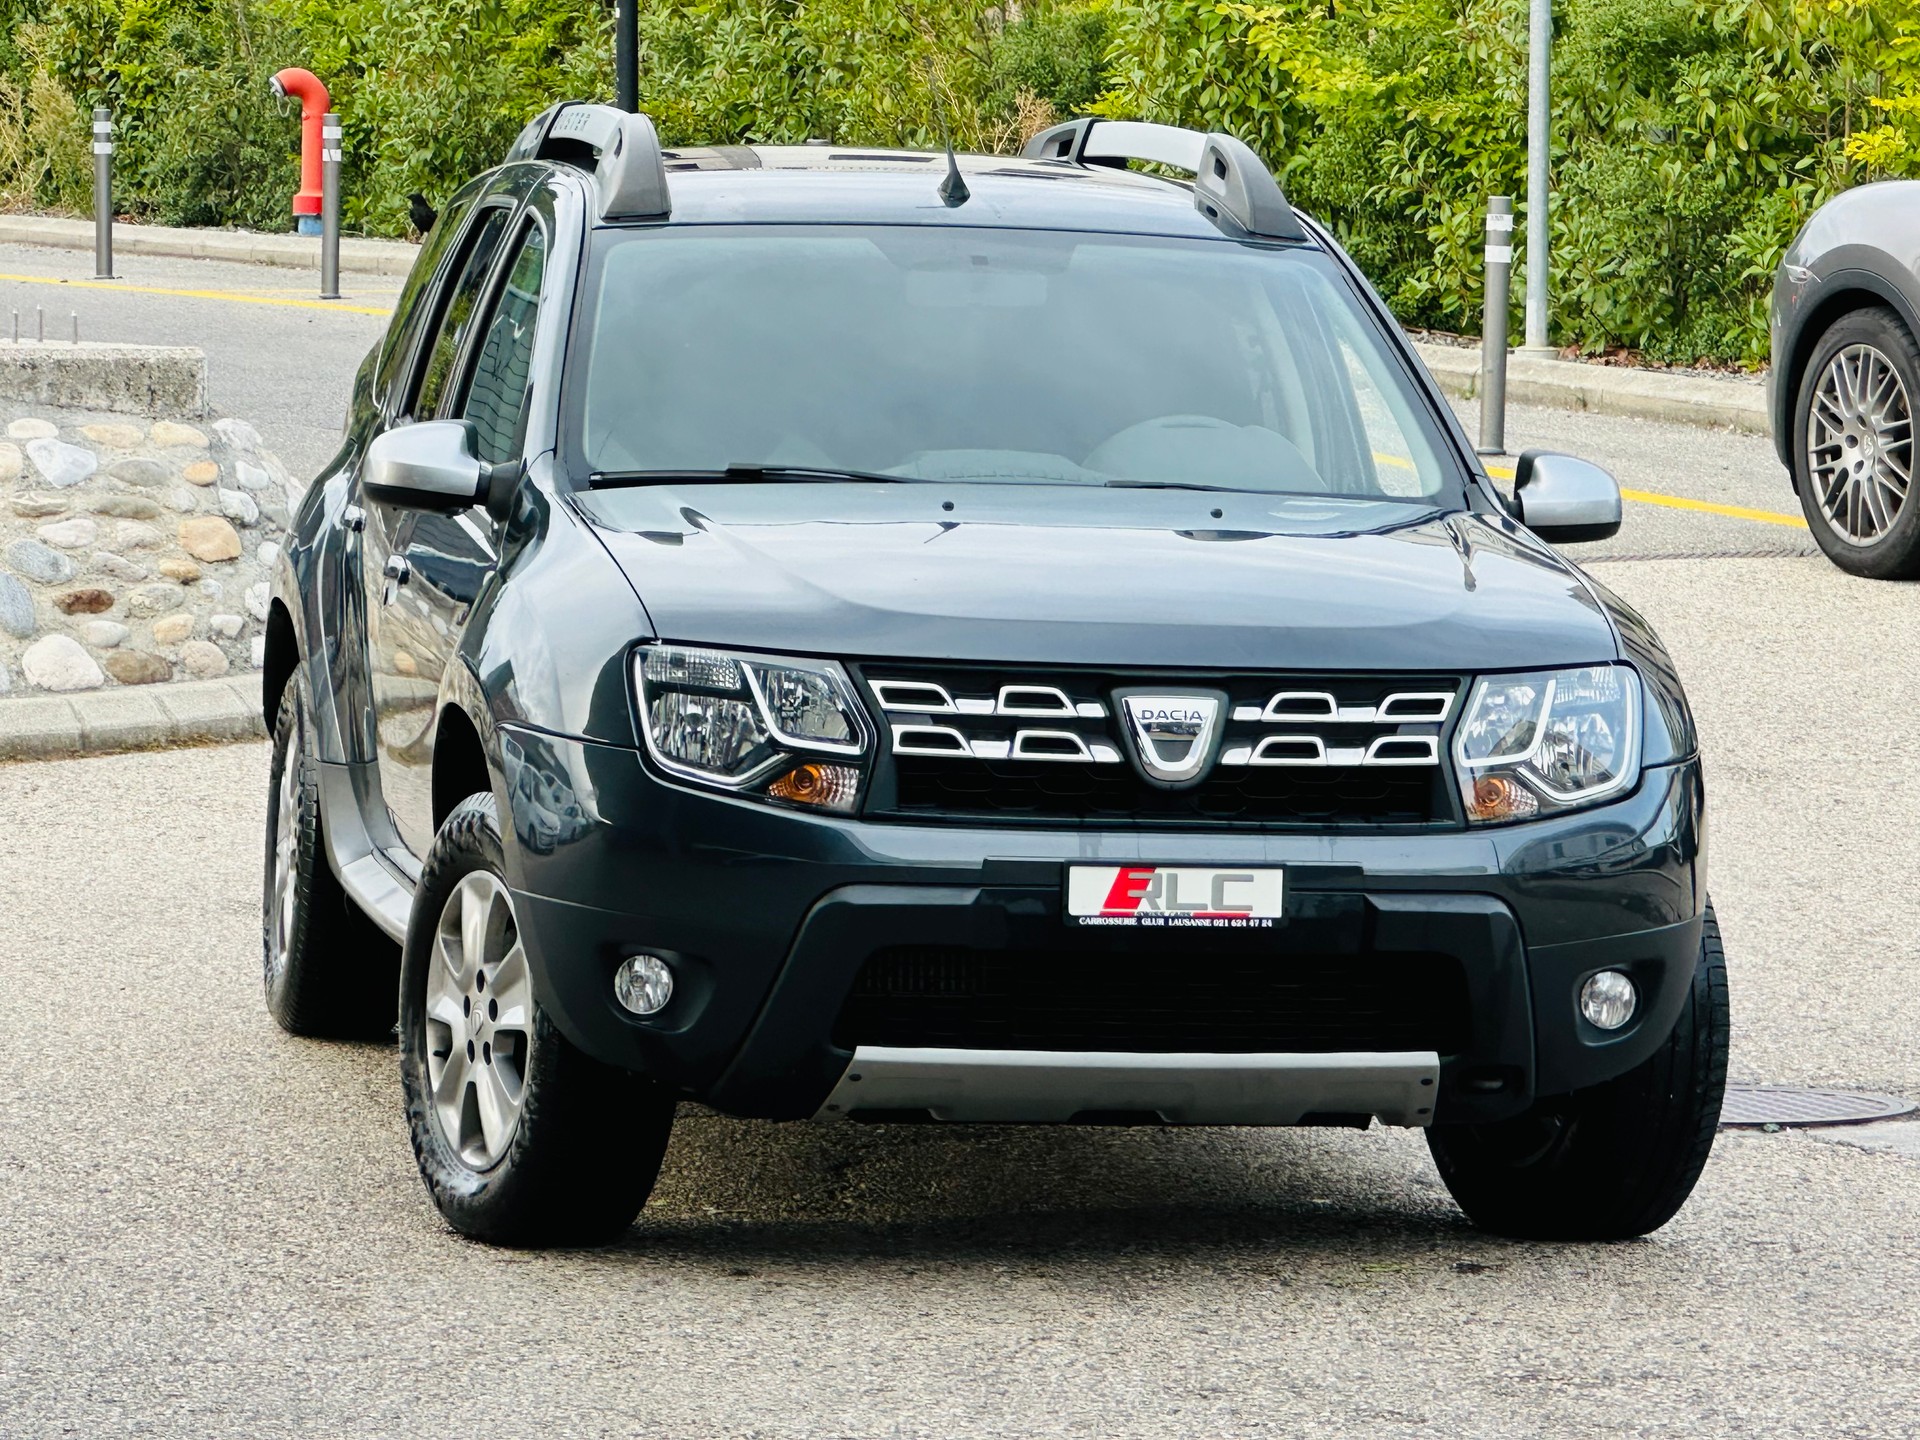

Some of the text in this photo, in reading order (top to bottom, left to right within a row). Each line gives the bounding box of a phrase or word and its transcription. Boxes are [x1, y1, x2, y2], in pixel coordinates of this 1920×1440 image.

[1141, 709, 1203, 722] DACIA
[1079, 917, 1138, 926] CARROSSERIE
[1168, 918, 1212, 927] LAUSANNE
[1213, 919, 1229, 927] 021
